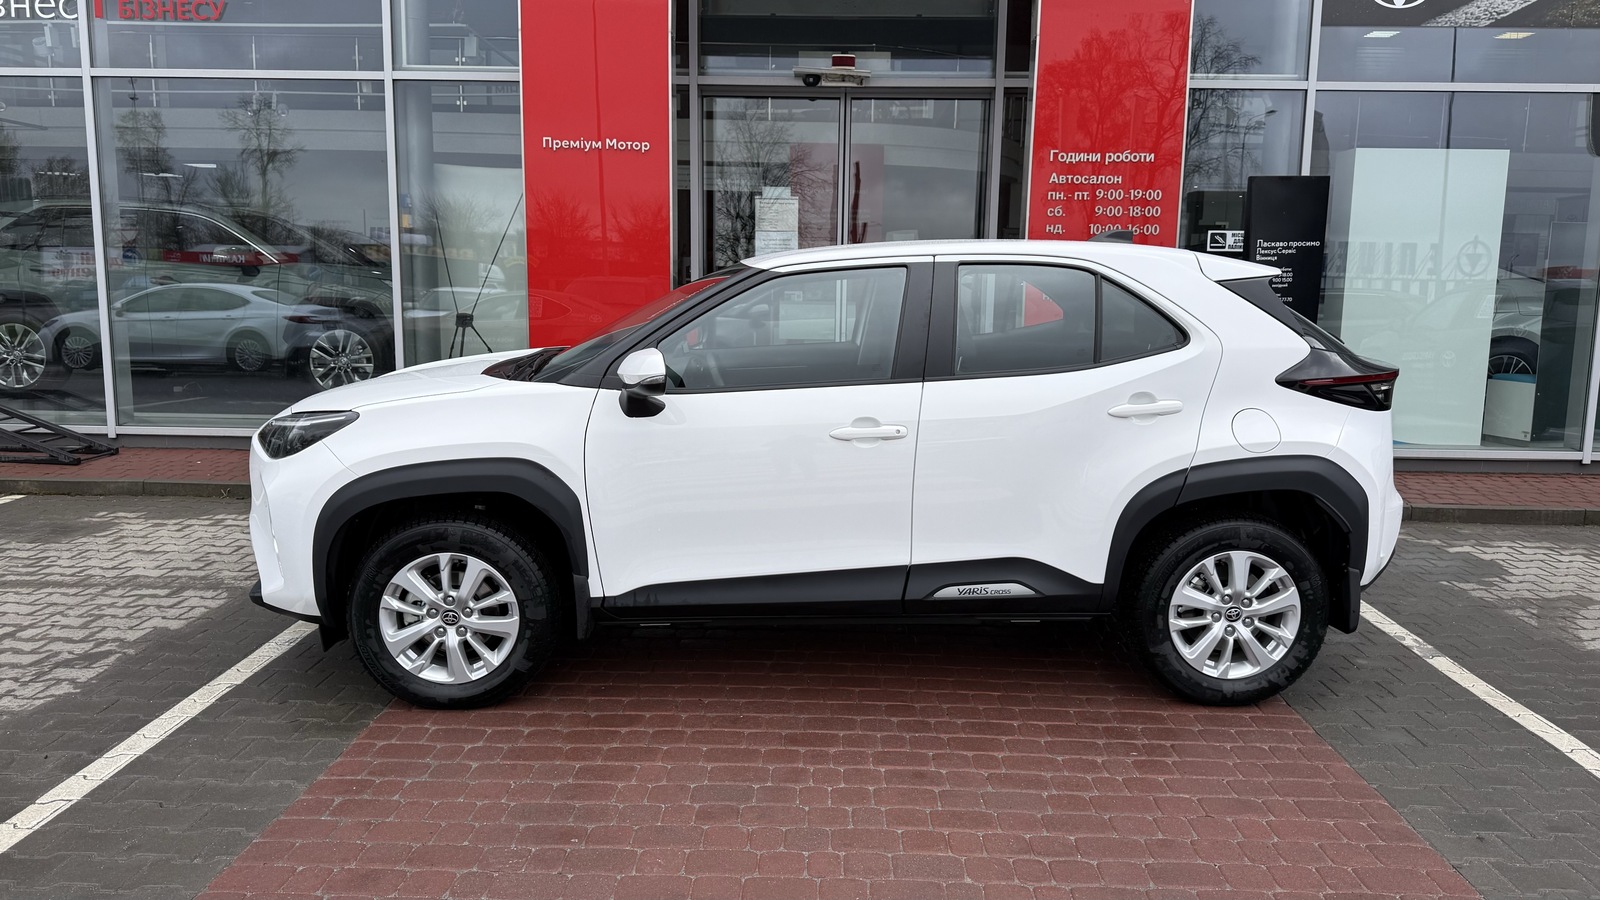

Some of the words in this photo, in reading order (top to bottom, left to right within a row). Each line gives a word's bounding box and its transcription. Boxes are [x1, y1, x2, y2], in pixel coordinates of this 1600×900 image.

[117, 0, 226, 21] БІЗНЕСУ
[542, 136, 602, 152] Преміум
[605, 137, 650, 153] Мотор
[1049, 149, 1101, 164] Години
[1105, 150, 1155, 165] роботи
[1049, 172, 1122, 184] Автосалон
[1095, 189, 1162, 201] 9:00-19:00
[1047, 205, 1066, 217] сб.
[1094, 205, 1161, 217] 9:00-18:00
[1045, 224, 1066, 235] нд.
[1256, 239, 1288, 248] Ласкаво
[1289, 240, 1321, 248] просимо
